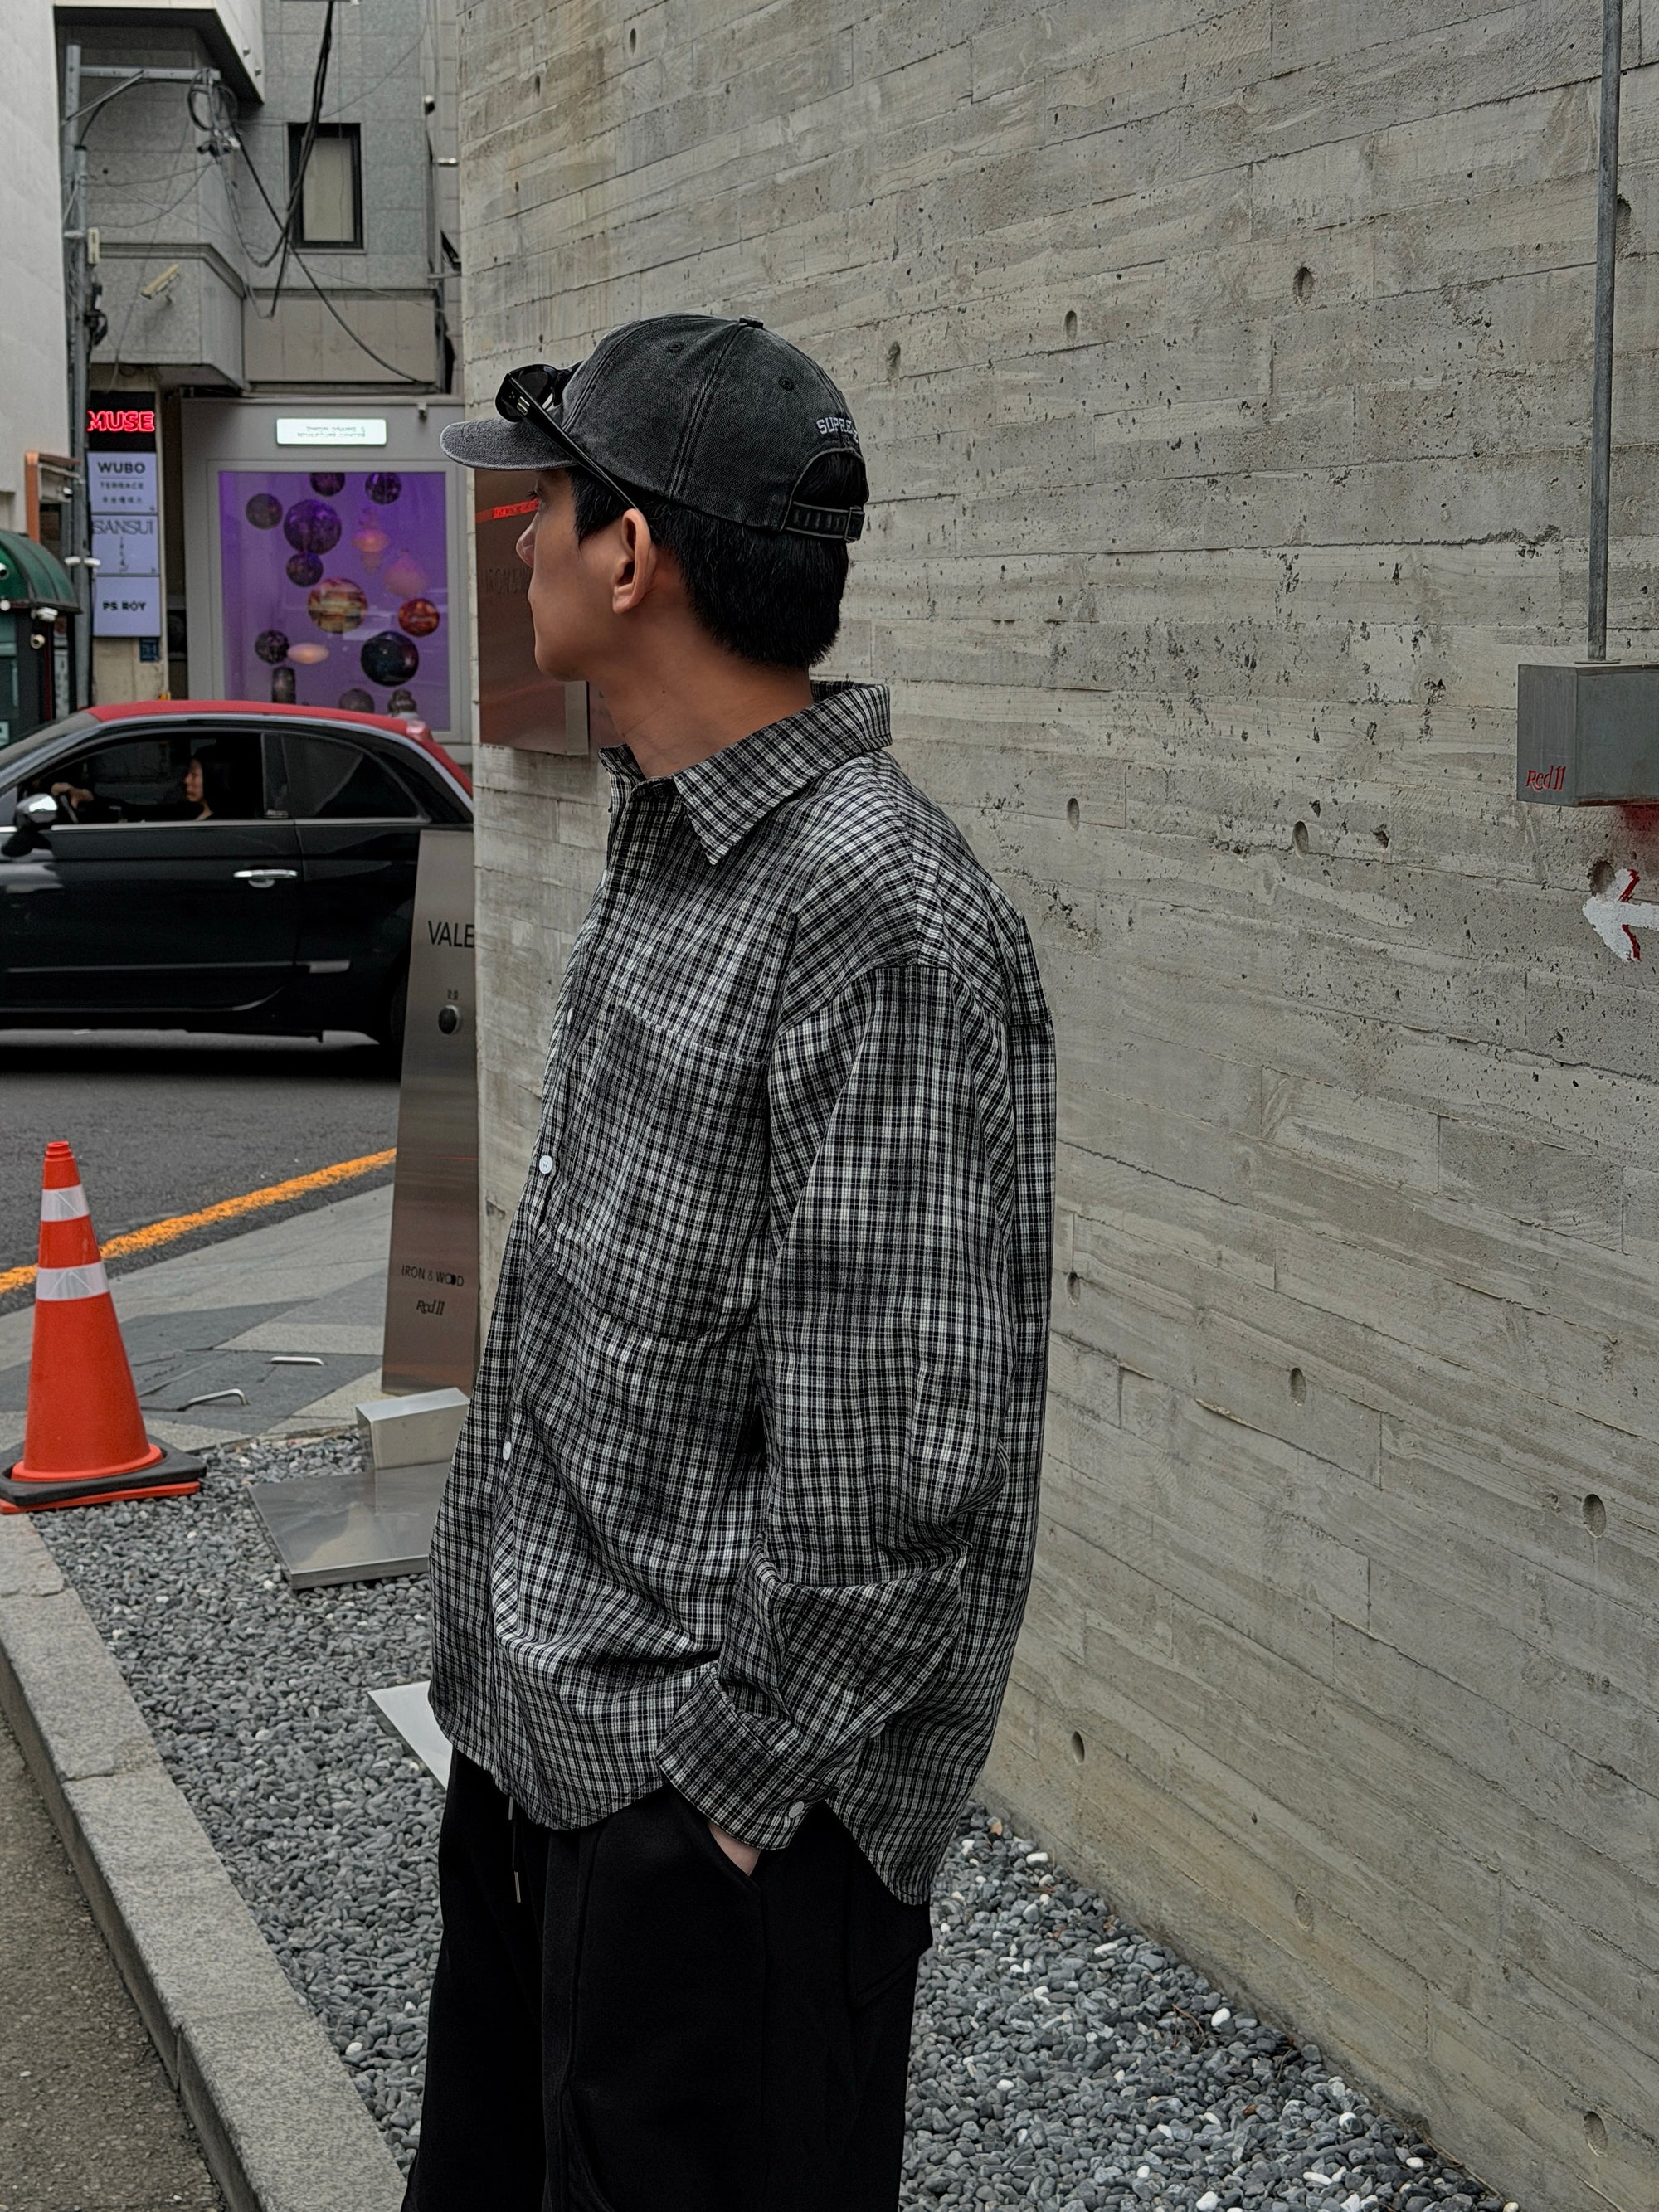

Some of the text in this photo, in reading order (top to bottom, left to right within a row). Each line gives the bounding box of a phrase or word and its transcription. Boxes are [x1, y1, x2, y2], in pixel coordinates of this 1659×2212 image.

[86, 410, 156, 432] MUSE
[97, 461, 146, 474] WUBO
[401, 1265, 426, 1281] IRON
